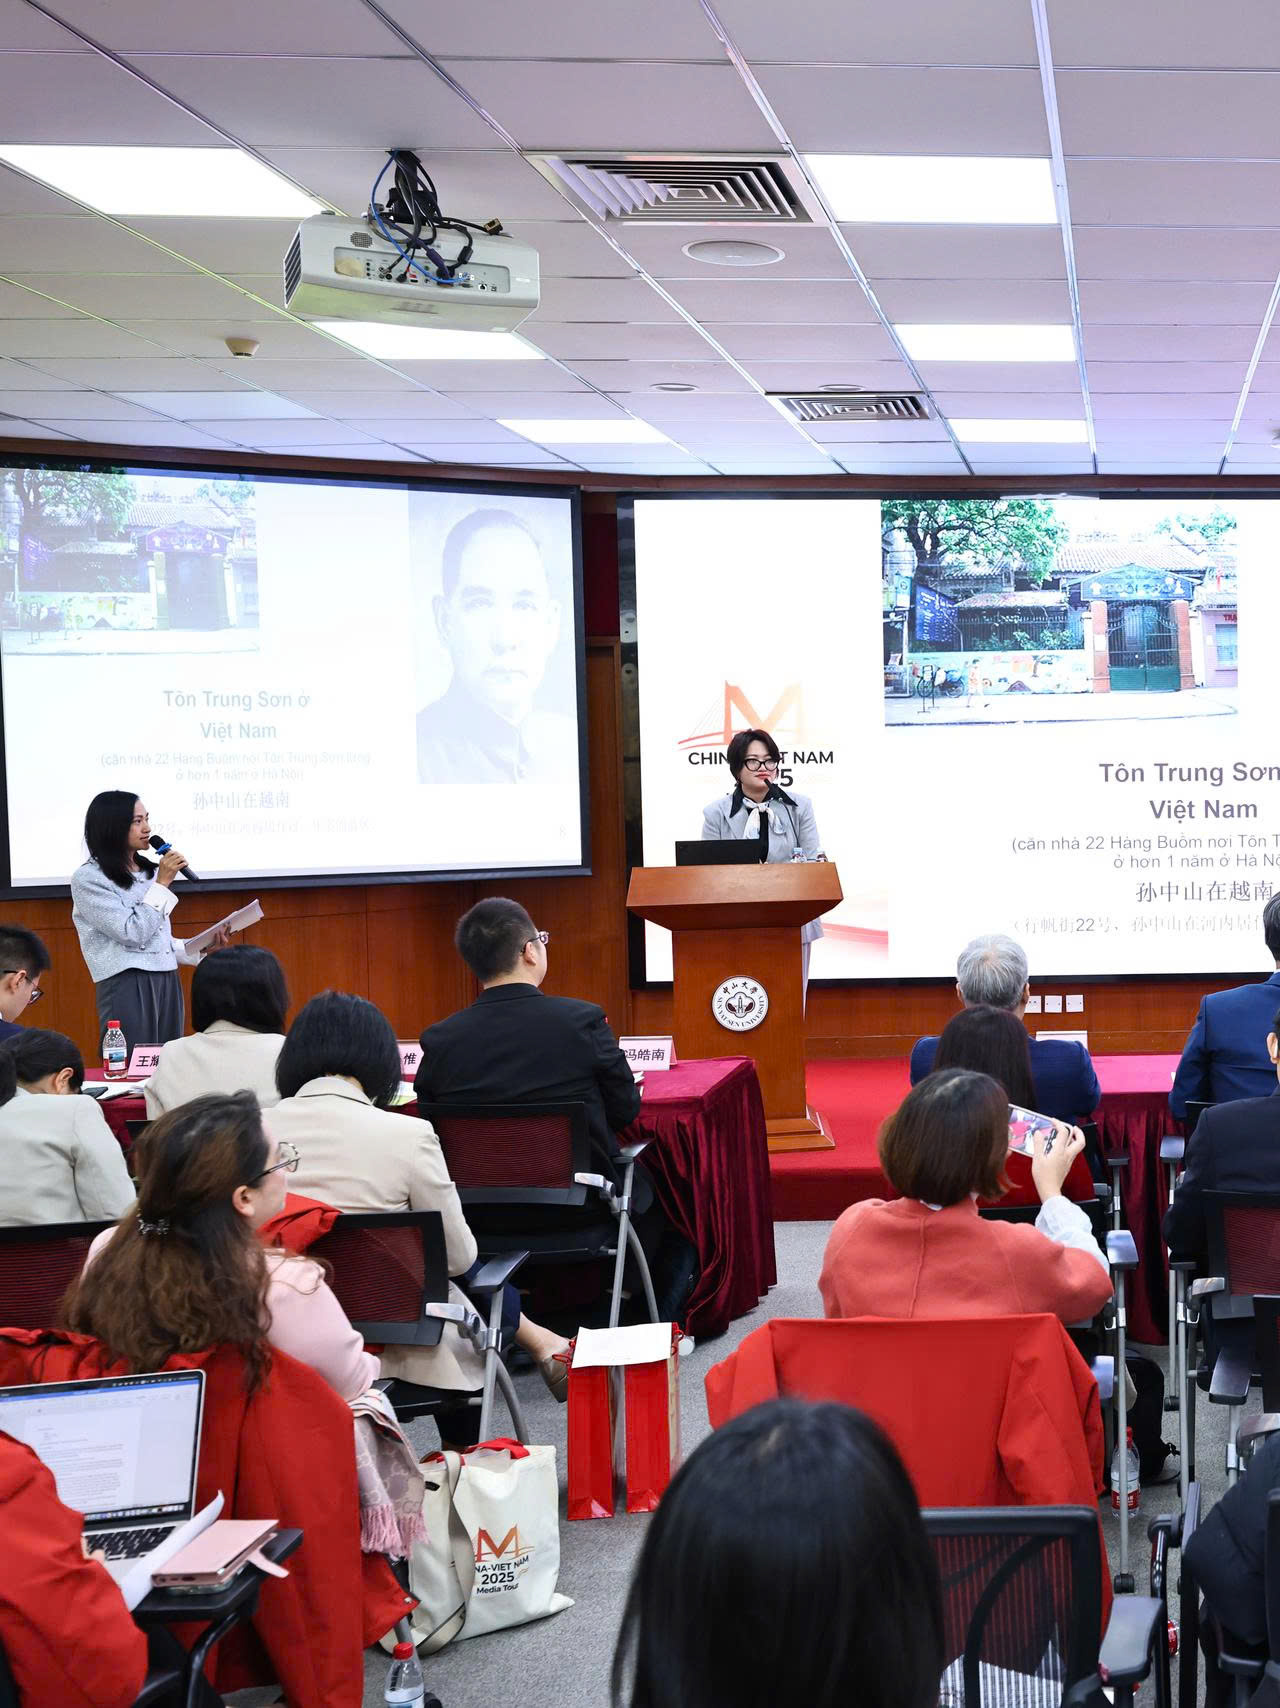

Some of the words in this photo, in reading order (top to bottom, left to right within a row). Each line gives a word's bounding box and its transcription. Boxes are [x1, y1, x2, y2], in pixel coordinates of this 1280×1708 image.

[163, 690, 197, 708] Tôn
[202, 690, 252, 711] Trung
[258, 690, 292, 708] Sơn
[200, 722, 233, 742] Việt
[239, 722, 277, 739] Nam
[155, 753, 169, 765] 22
[793, 751, 834, 764] NAM
[1099, 763, 1145, 782] Tôn
[1153, 763, 1223, 787] Trung
[1232, 762, 1280, 781] Sơn
[1149, 799, 1196, 824] Việt
[1204, 799, 1258, 819] Nam
[1012, 836, 1046, 853] (căn
[1051, 836, 1081, 850] nhà
[1085, 836, 1105, 850] 22
[1110, 836, 1152, 852] Hàng
[1157, 832, 1202, 849] Buồm
[1208, 834, 1233, 849] nơi
[1237, 833, 1267, 848] Tôn
[1113, 854, 1125, 869] ở
[1130, 854, 1160, 869] hơn
[1167, 855, 1174, 868] 1
[1181, 854, 1214, 868] năm
[1219, 853, 1230, 868] ở
[1236, 853, 1257, 867] Hà
[1135, 880, 1273, 902] 孙中山在越南
[624, 1048, 665, 1061] 冯皓南
[474, 1563, 511, 1574] NA-VIET
[514, 1555, 529, 1568] NAM
[481, 1571, 515, 1585] 2025
[476, 1585, 501, 1594] Media
[503, 1583, 519, 1591] Tour
